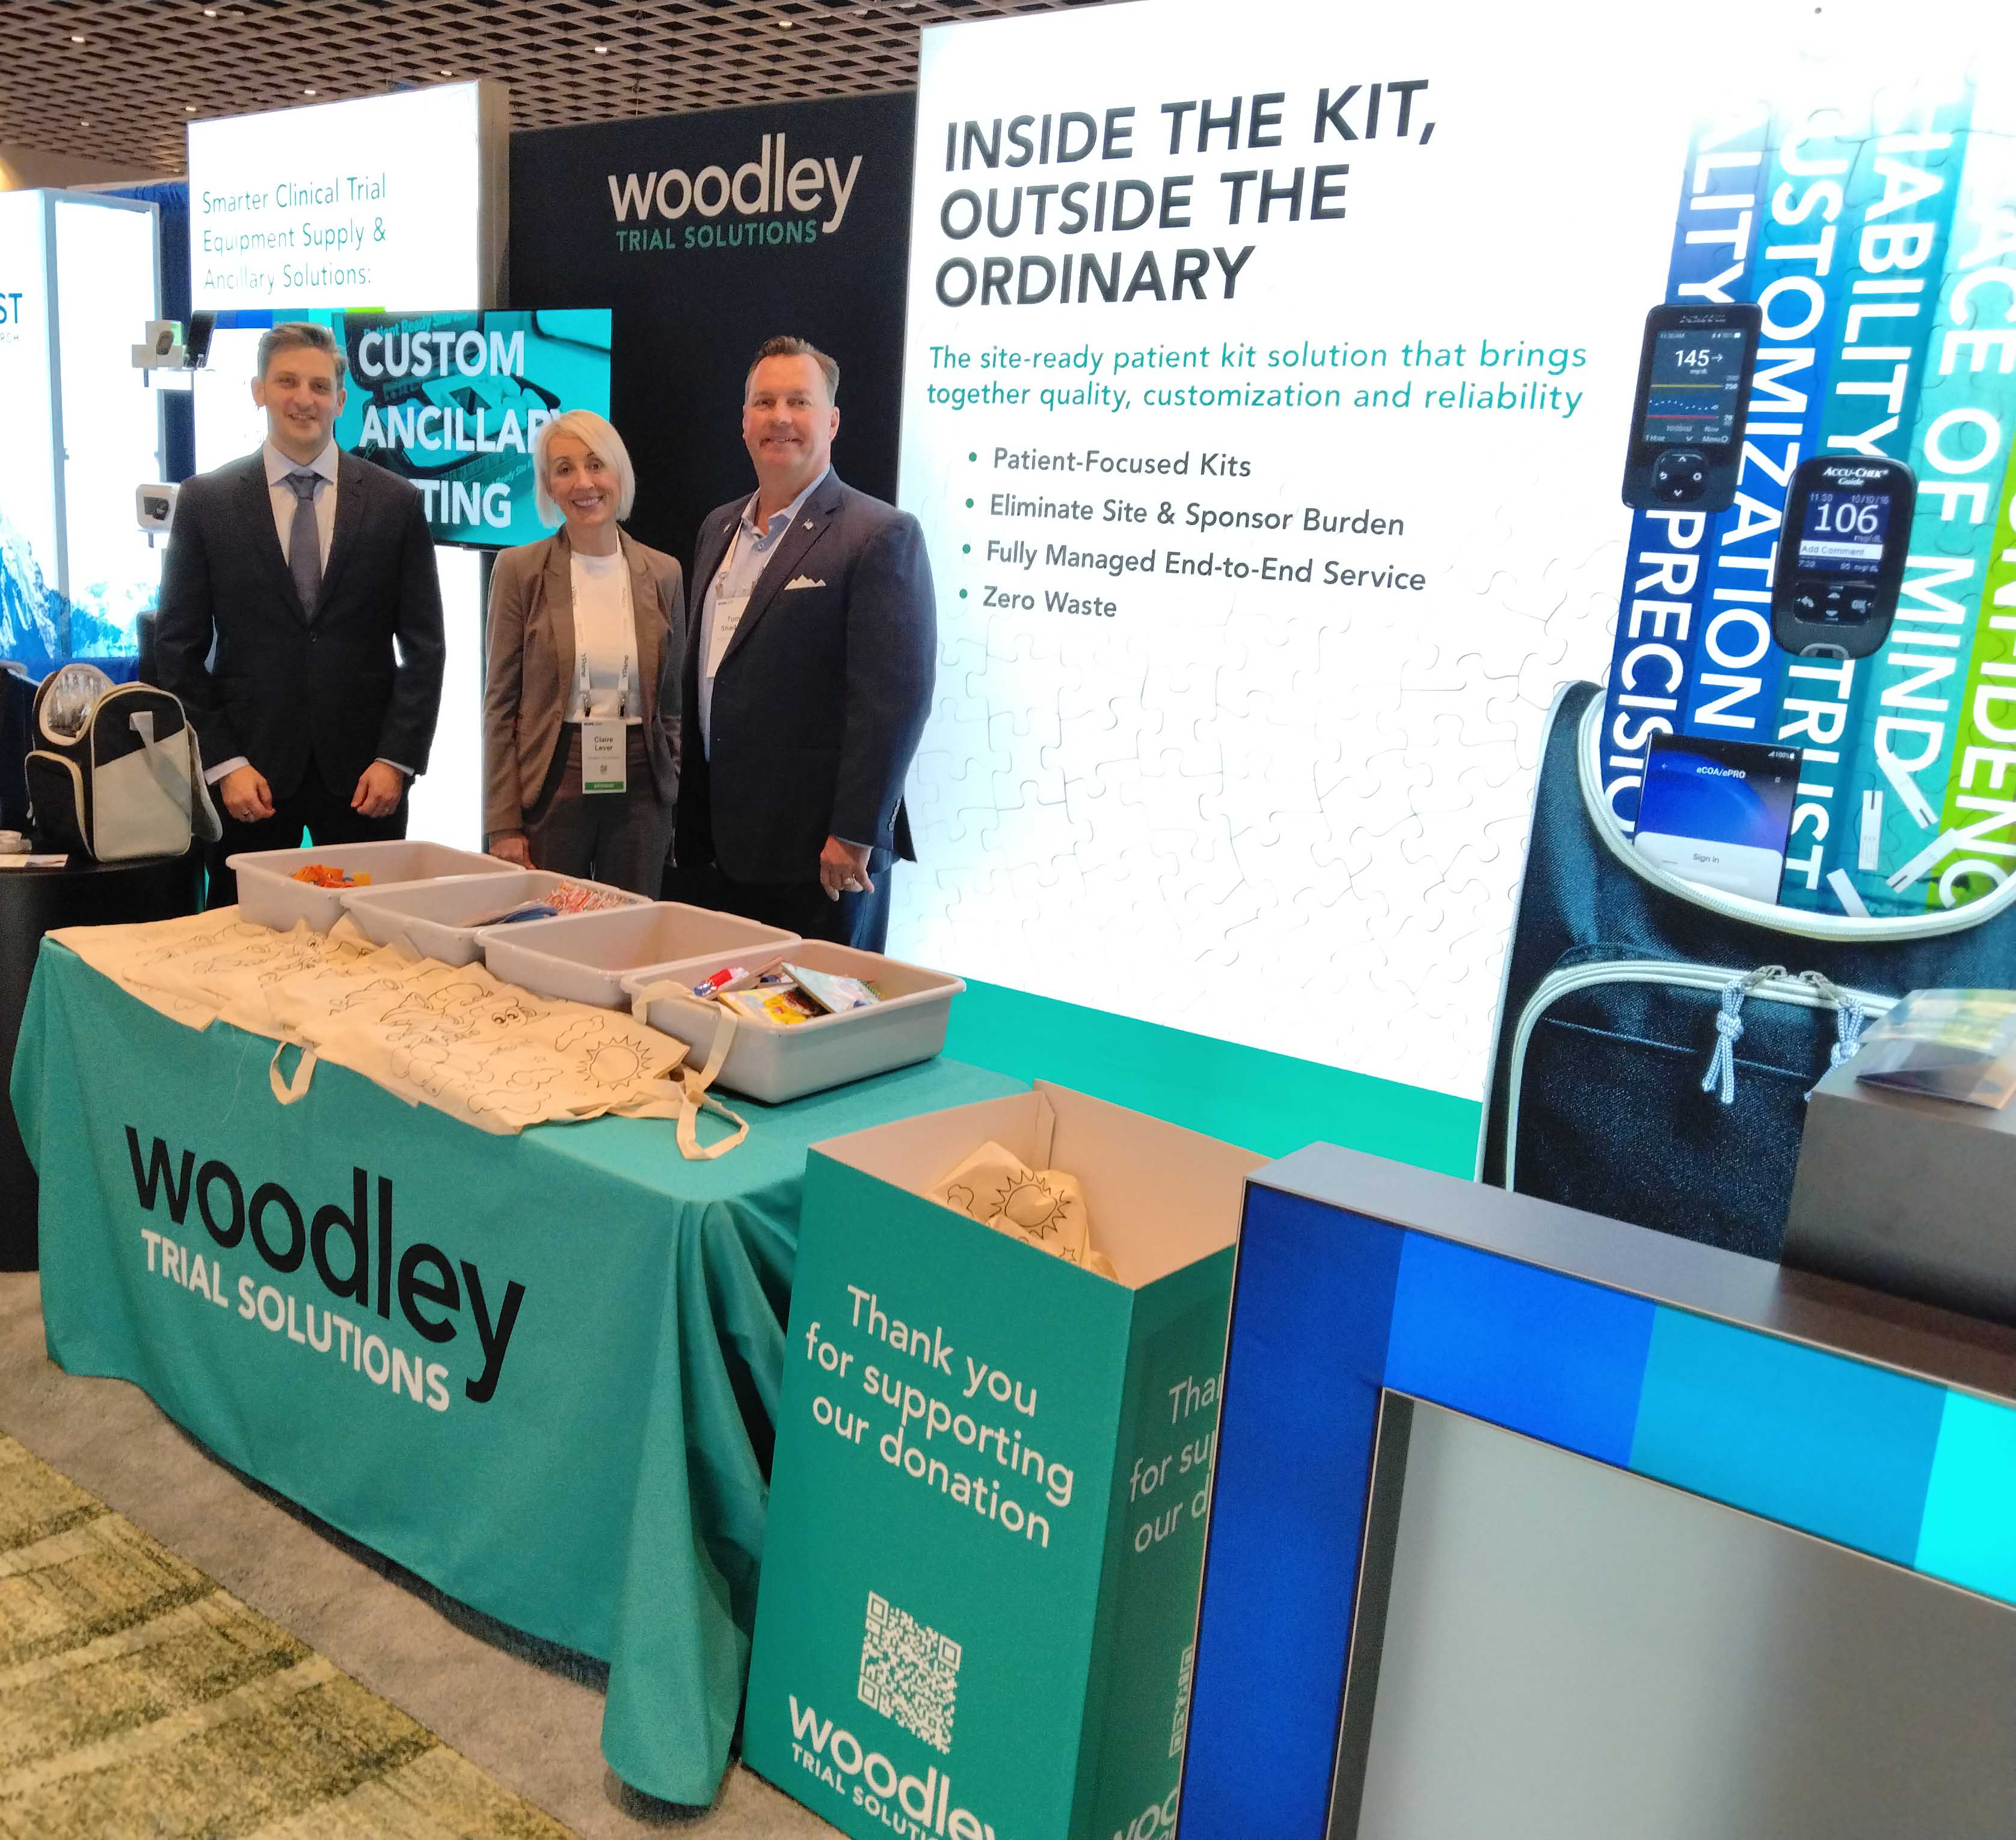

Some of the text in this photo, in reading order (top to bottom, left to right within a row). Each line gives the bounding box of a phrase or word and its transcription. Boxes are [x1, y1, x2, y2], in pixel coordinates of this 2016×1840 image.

[945, 79, 1436, 171] INSIDE THE KIT,
[203, 173, 386, 215] Smarter Clinical Trial
[607, 132, 863, 234] woodley
[941, 164, 1350, 241] OUTSIDE THE
[204, 216, 387, 256] Equipment Supply &
[616, 219, 817, 252] TRIAL SOLUTIONS
[204, 263, 372, 296] Ancillary Solutions:
[935, 245, 1256, 308] ORDINARY
[359, 331, 524, 376] CUSTOM
[929, 339, 1587, 376] The site-ready patient kit solution that brings
[1675, 349, 1710, 367] 145
[927, 380, 1584, 419] together quality, customization and reliability
[359, 405, 562, 453] ANCILLAR
[1694, 123, 1849, 729] USTOMIZATION
[994, 447, 1252, 479] Patient-Focused Kits
[1838, 478, 1864, 486] Guide
[1916, 408, 2002, 524] OF
[409, 479, 511, 528] TING
[990, 494, 1406, 537] Eliminate Site & Sponsor Burden
[1814, 503, 1878, 533] 106
[986, 540, 1427, 592] Fully Managed End-to-End Service
[1822, 547, 1864, 556] Comment
[983, 586, 1117, 619] Zero Waste
[1874, 554, 1975, 772] MIND
[1696, 766, 1745, 779] eCOA/ePRO
[1693, 853, 1710, 862] Sign
[124, 1124, 526, 1403] woodley
[141, 1228, 449, 1412] TRIAL SOLUTIONS
[847, 1284, 1037, 1417] Thank you
[805, 1322, 1074, 1508] for supporting
[813, 1396, 1050, 1548] our donation
[1129, 1457, 1172, 1502] for
[1135, 1502, 1184, 1552] our
[789, 1694, 997, 1840] woodle
[791, 1743, 846, 1796] TRIAL
